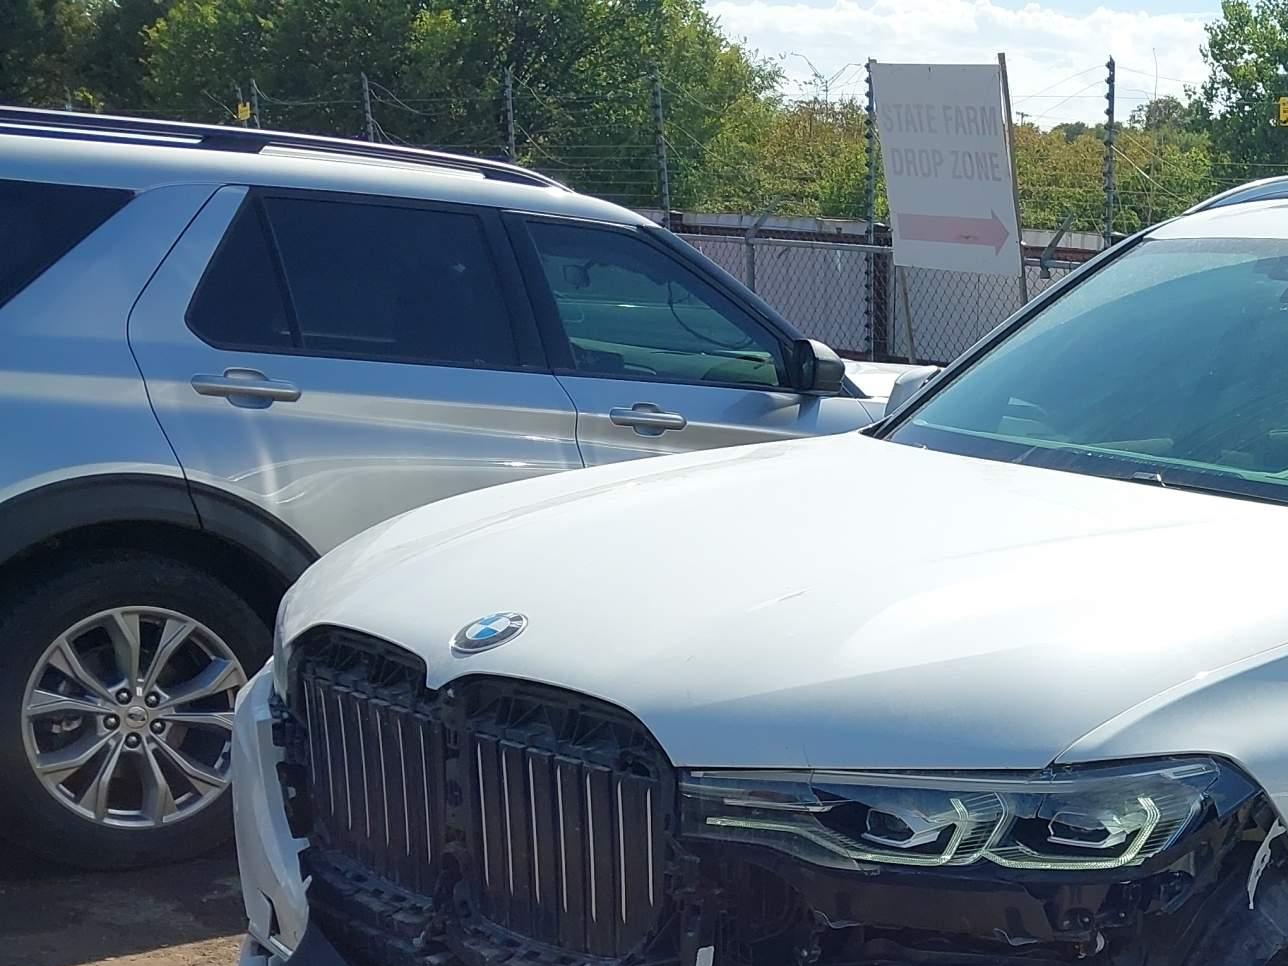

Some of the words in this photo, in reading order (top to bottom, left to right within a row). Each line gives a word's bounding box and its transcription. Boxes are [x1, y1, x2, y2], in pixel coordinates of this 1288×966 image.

[881, 103, 938, 134] STATE
[942, 104, 998, 137] FARM
[890, 147, 943, 178] DROP
[949, 150, 1002, 182] ZONE
